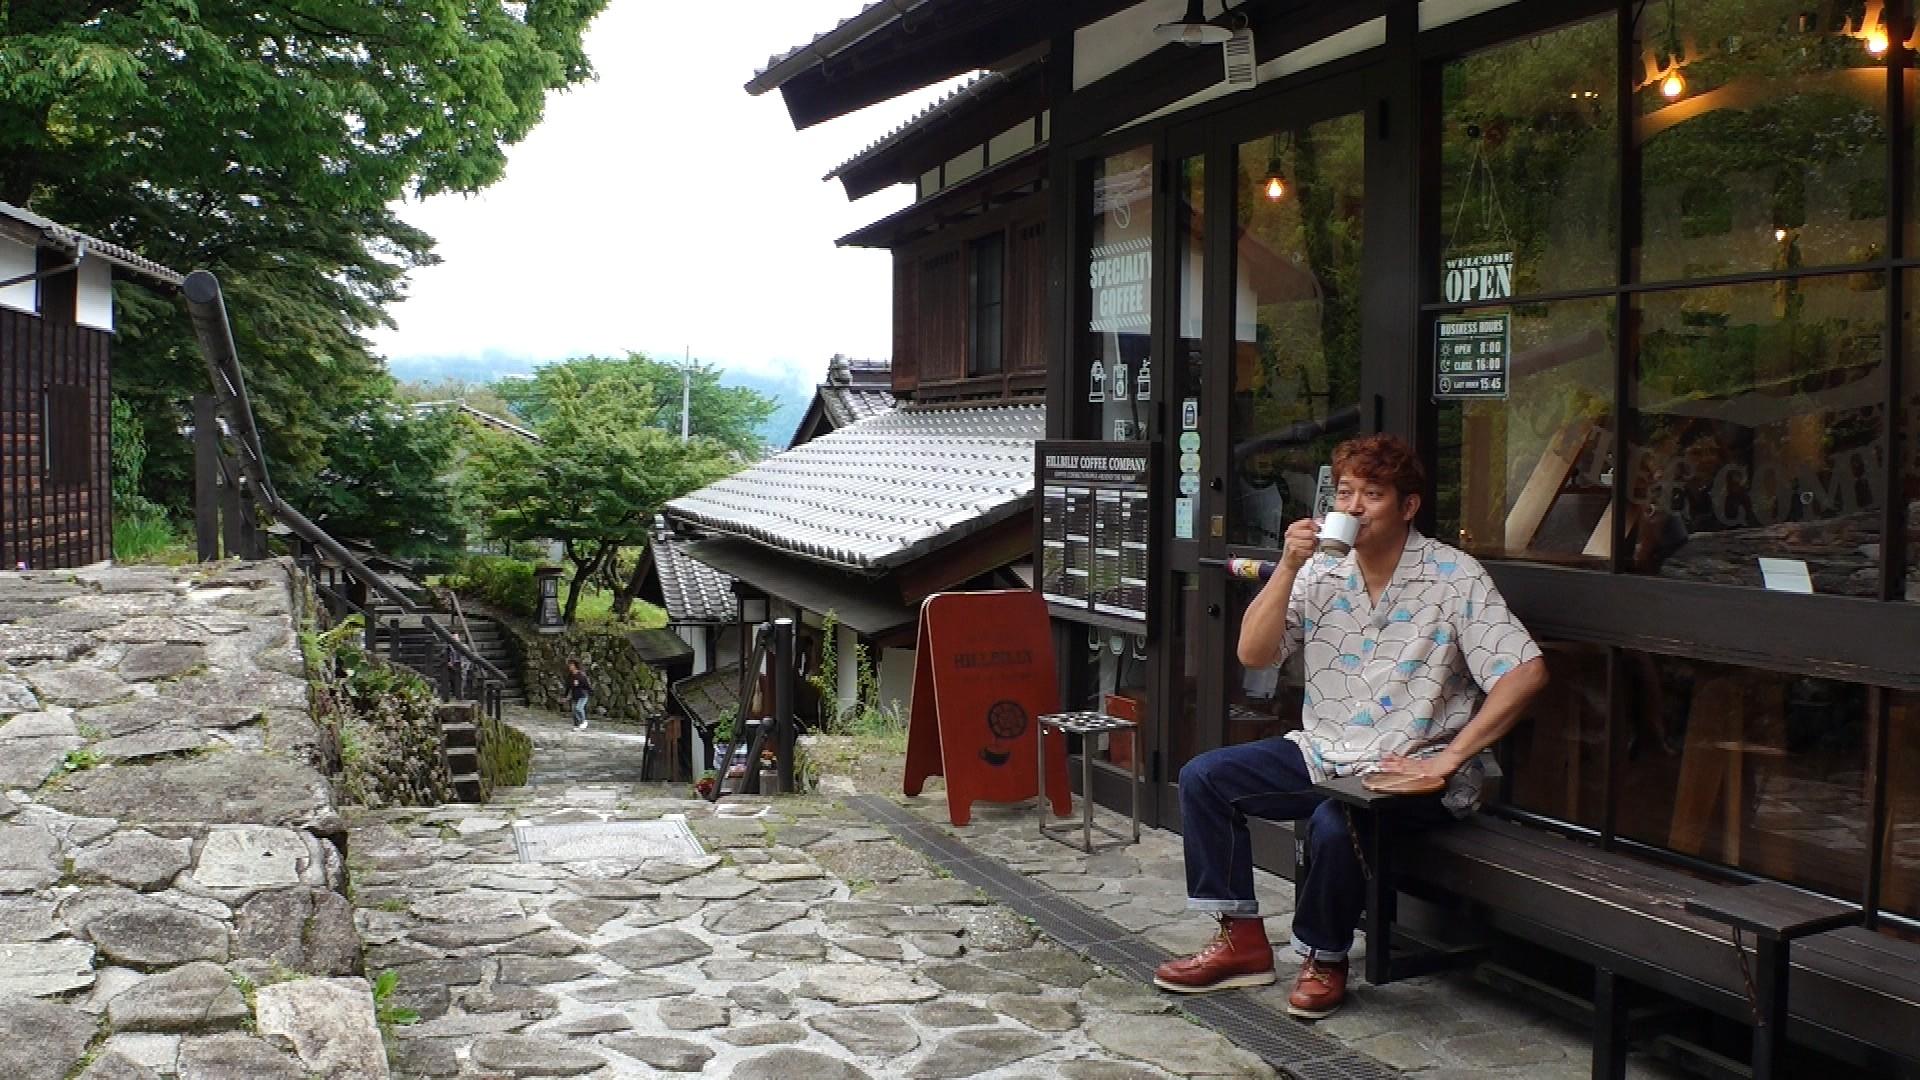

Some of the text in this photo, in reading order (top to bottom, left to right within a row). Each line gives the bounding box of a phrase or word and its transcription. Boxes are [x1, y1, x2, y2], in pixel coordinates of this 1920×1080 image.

[1446, 252, 1514, 269] WELCOME
[1445, 264, 1513, 303] OPEN
[1100, 284, 1143, 317] COFFEE
[1440, 320, 1503, 337] BUSINESS HOURS
[1454, 341, 1501, 355] OPEN 8:00
[1454, 358, 1501, 371] CLOSE 16:00
[1480, 378, 1501, 390] 15:45
[1045, 455, 1147, 472] HILLBILLY COFFEE COMPANY
